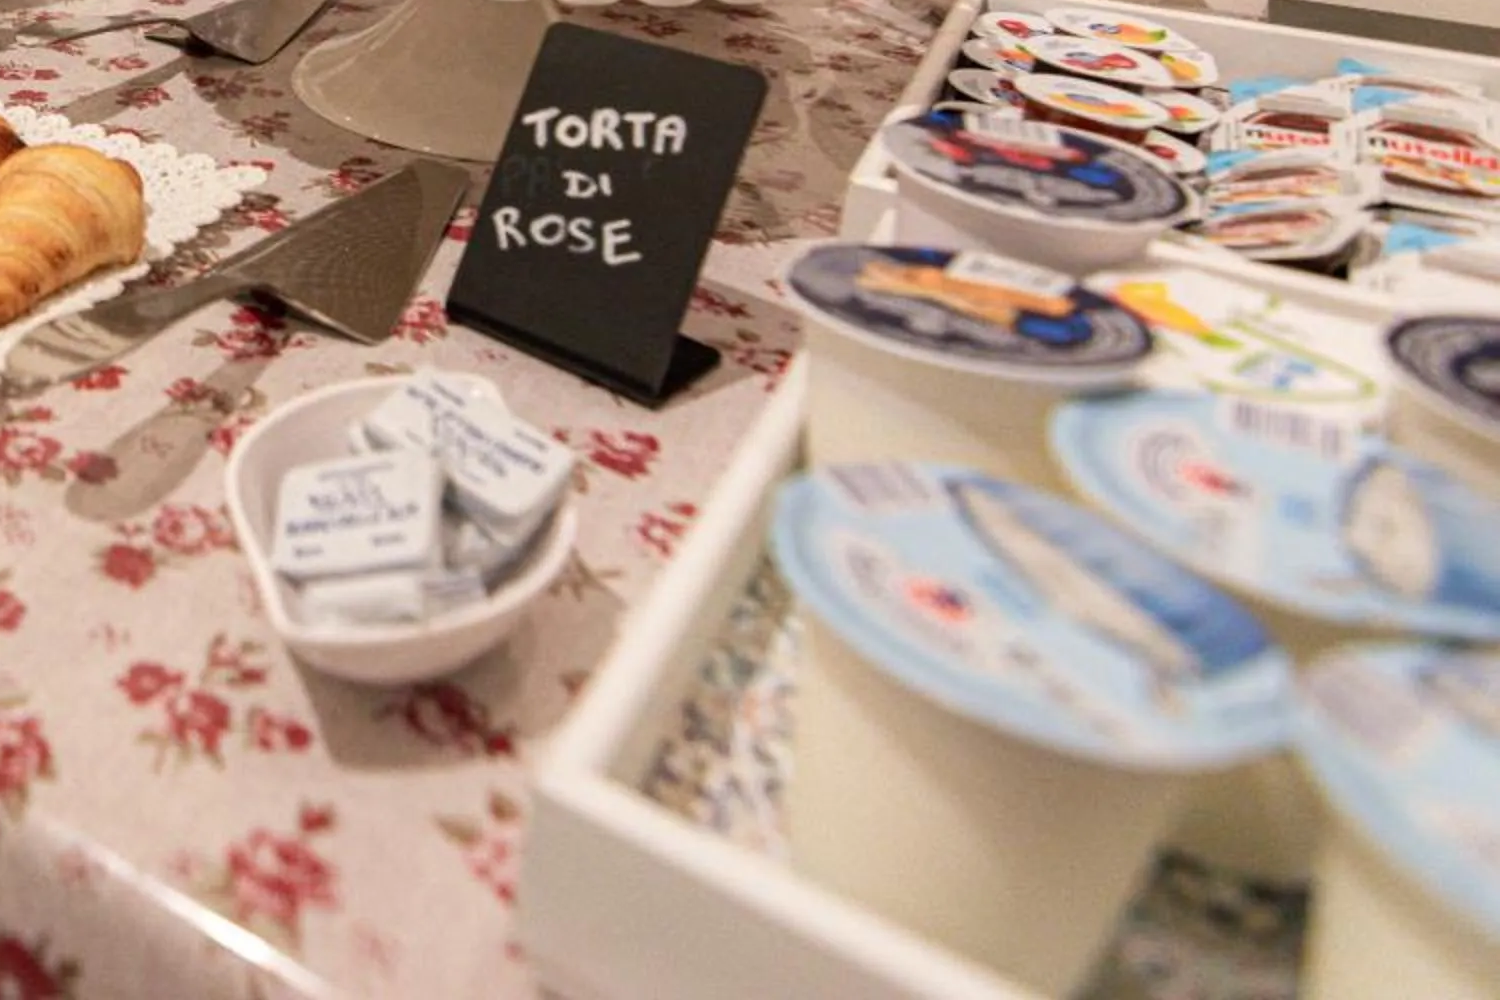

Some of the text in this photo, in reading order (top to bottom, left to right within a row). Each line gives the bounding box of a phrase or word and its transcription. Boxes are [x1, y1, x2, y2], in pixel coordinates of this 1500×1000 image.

[522, 107, 688, 154] TORTA
[1368, 136, 1500, 172] nutella
[561, 169, 613, 198] DI
[492, 206, 642, 266] ROSE
